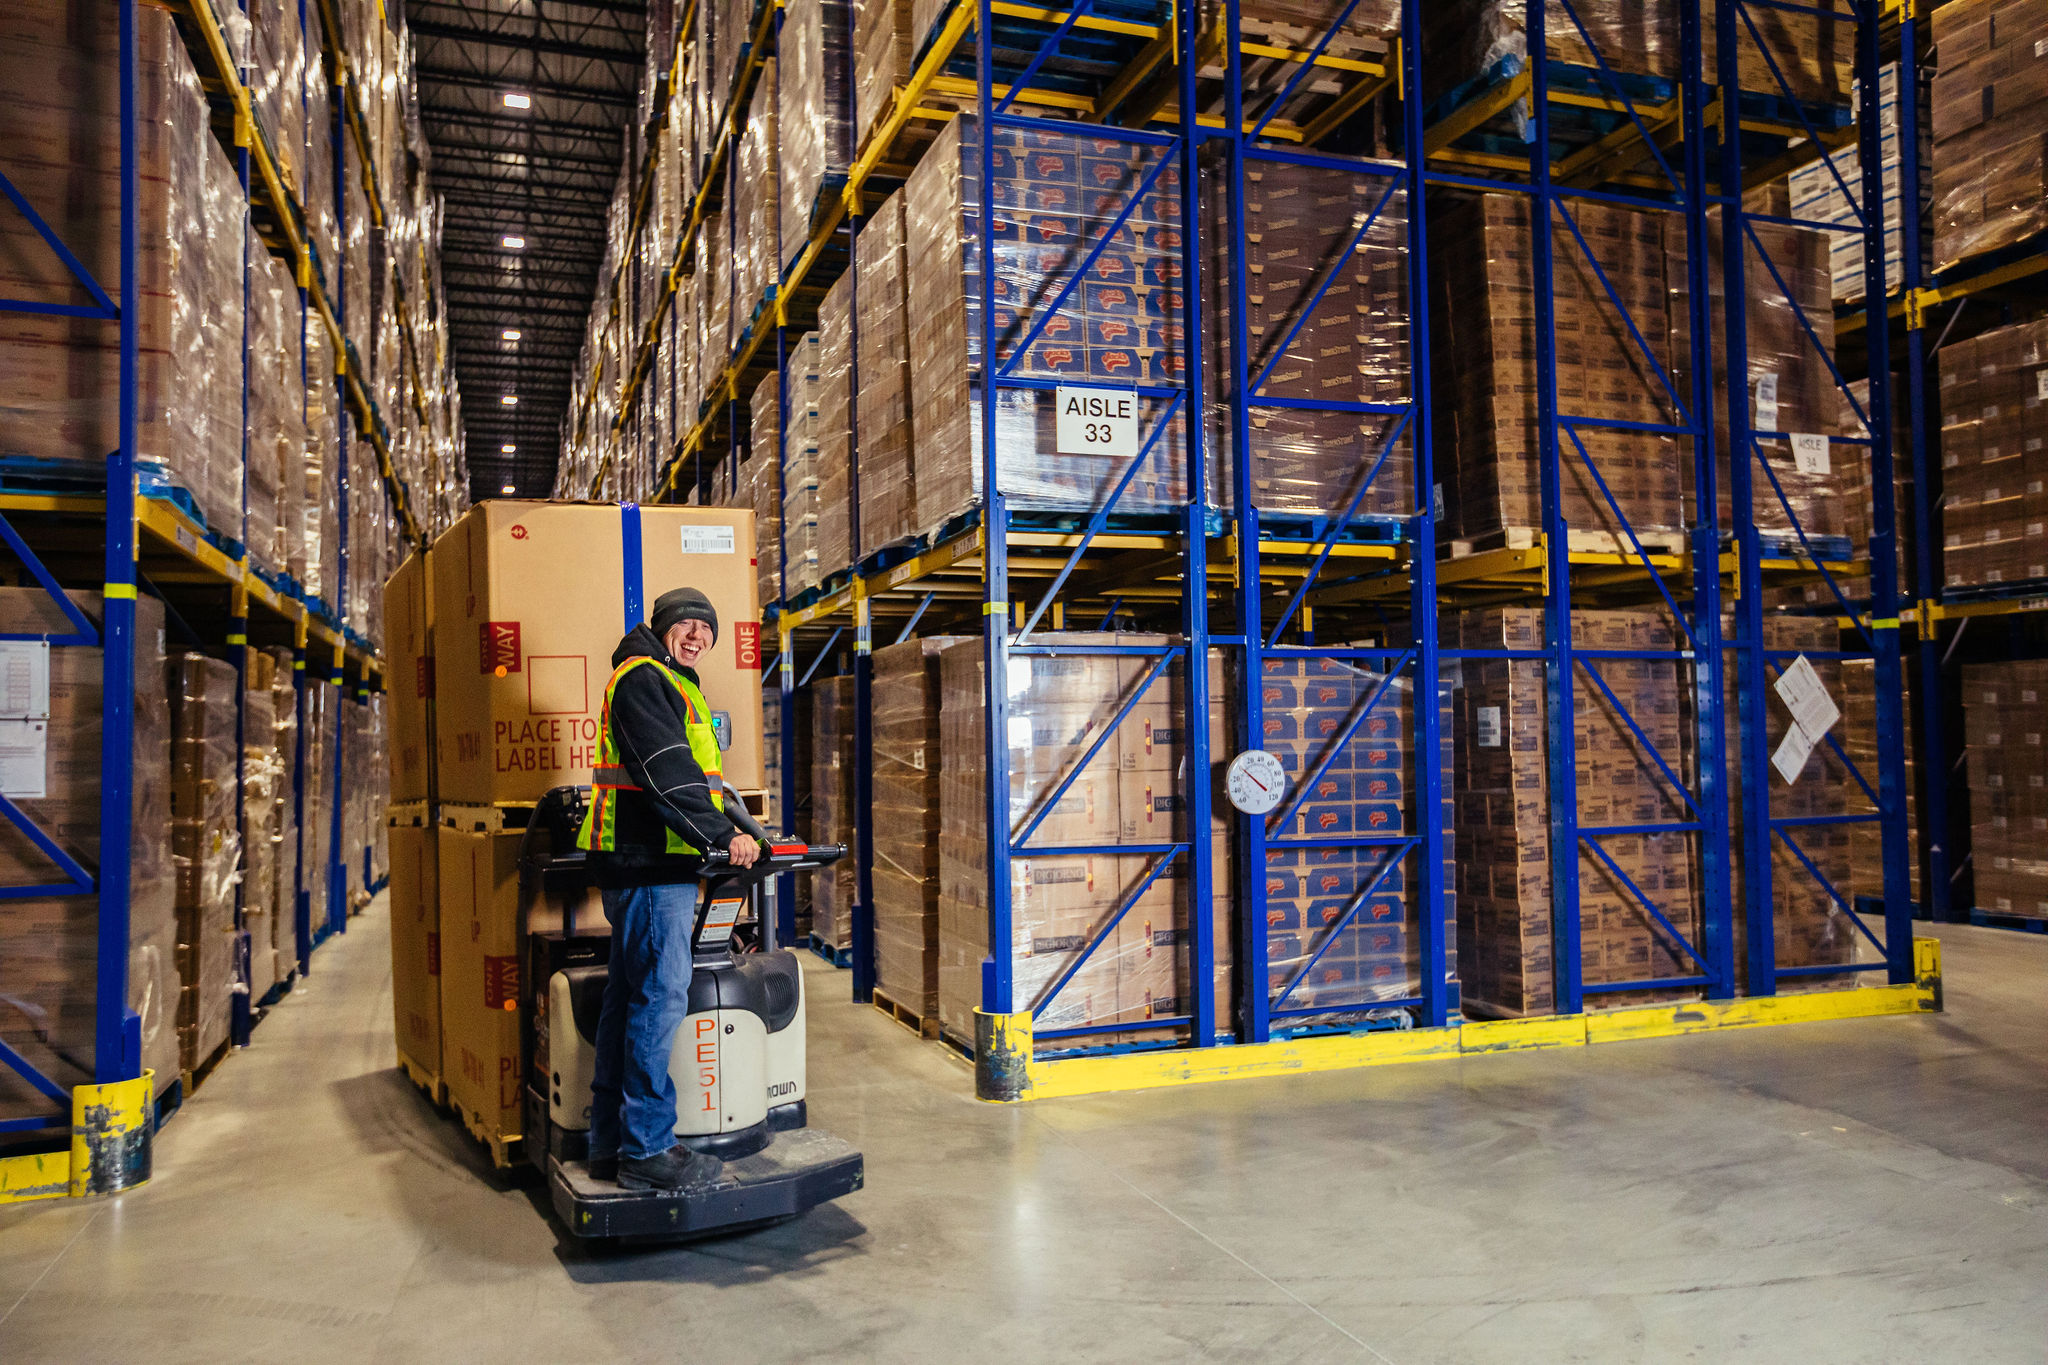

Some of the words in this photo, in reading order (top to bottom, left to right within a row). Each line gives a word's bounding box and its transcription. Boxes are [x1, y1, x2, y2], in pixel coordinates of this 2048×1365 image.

[1065, 396, 1131, 419] AISLE
[1085, 423, 1112, 443] 33
[1798, 438, 1822, 451] AISLE
[496, 626, 515, 667] WAY
[741, 626, 756, 664] ONE
[495, 720, 561, 744] PLACE
[568, 718, 600, 742] TO
[496, 746, 562, 772] LABEL
[502, 960, 520, 1001] WAY
[695, 1018, 717, 1112] PE51
